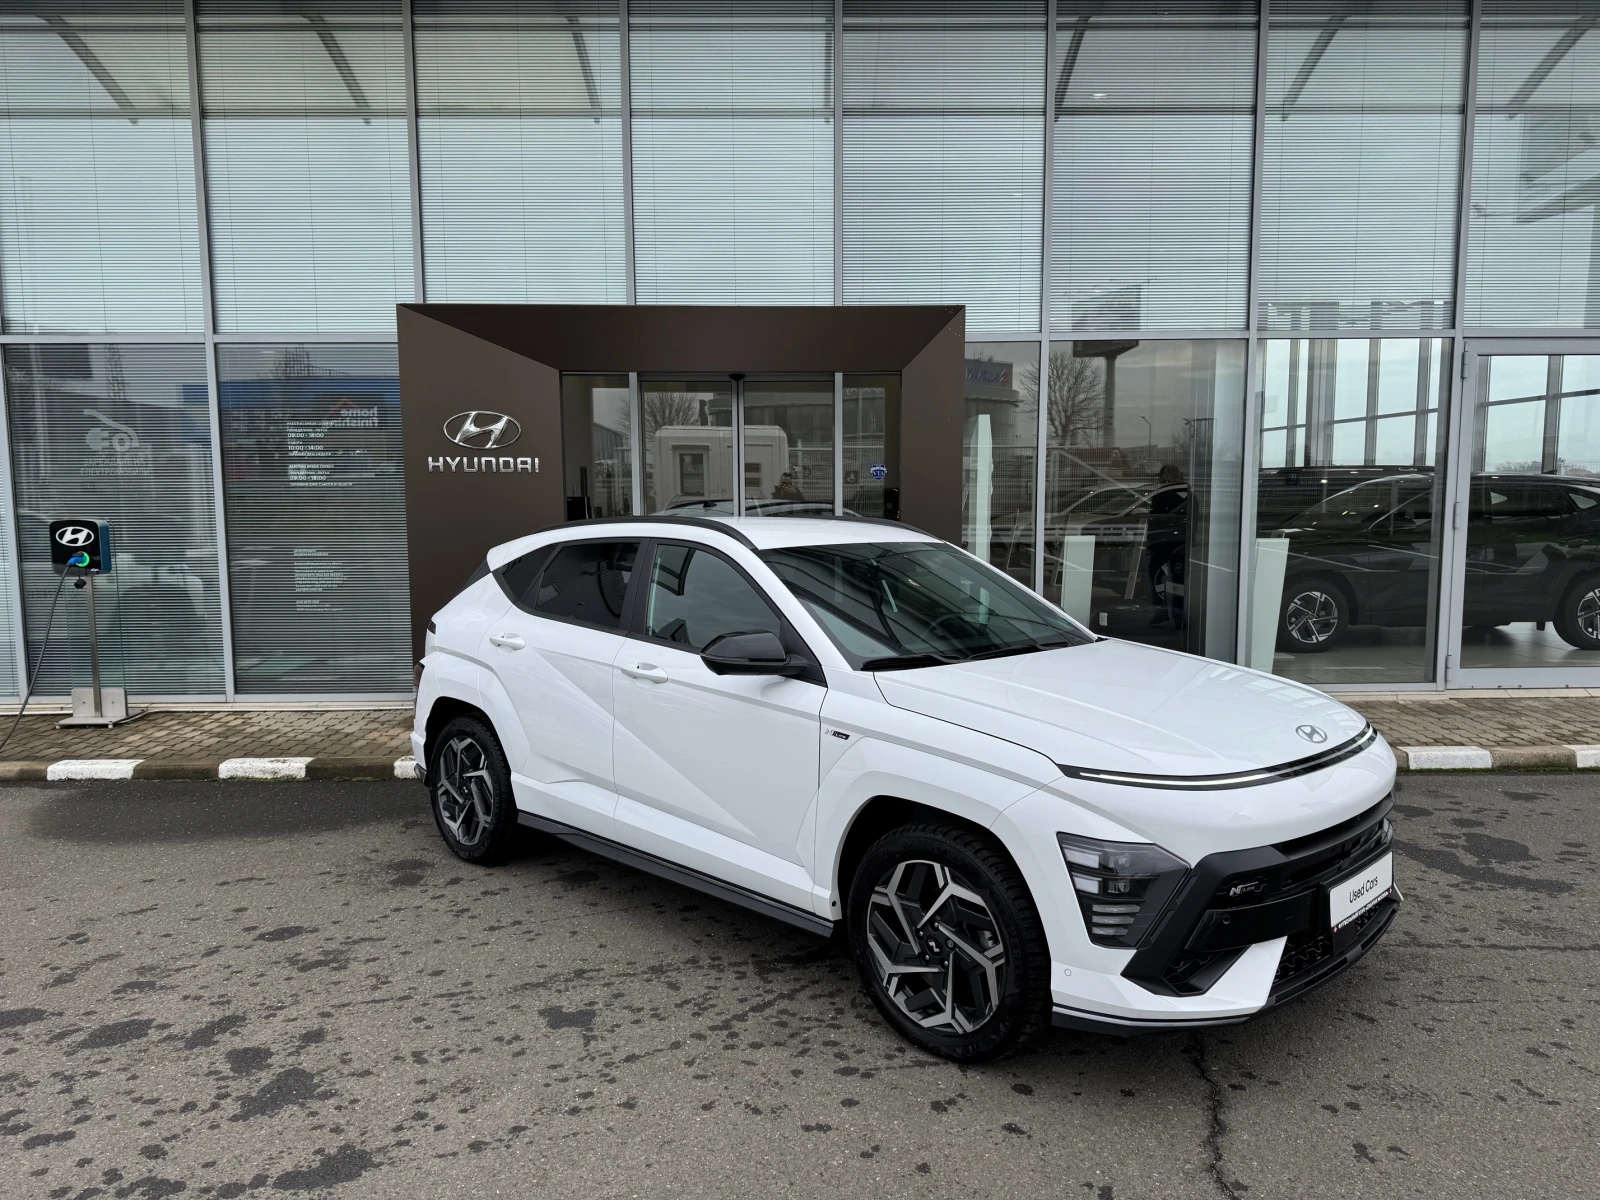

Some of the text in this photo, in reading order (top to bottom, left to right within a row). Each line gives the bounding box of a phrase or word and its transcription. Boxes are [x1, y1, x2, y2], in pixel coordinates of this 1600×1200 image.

[427, 456, 540, 473] HYUNDAI
[1349, 876, 1378, 903] Used Cars
